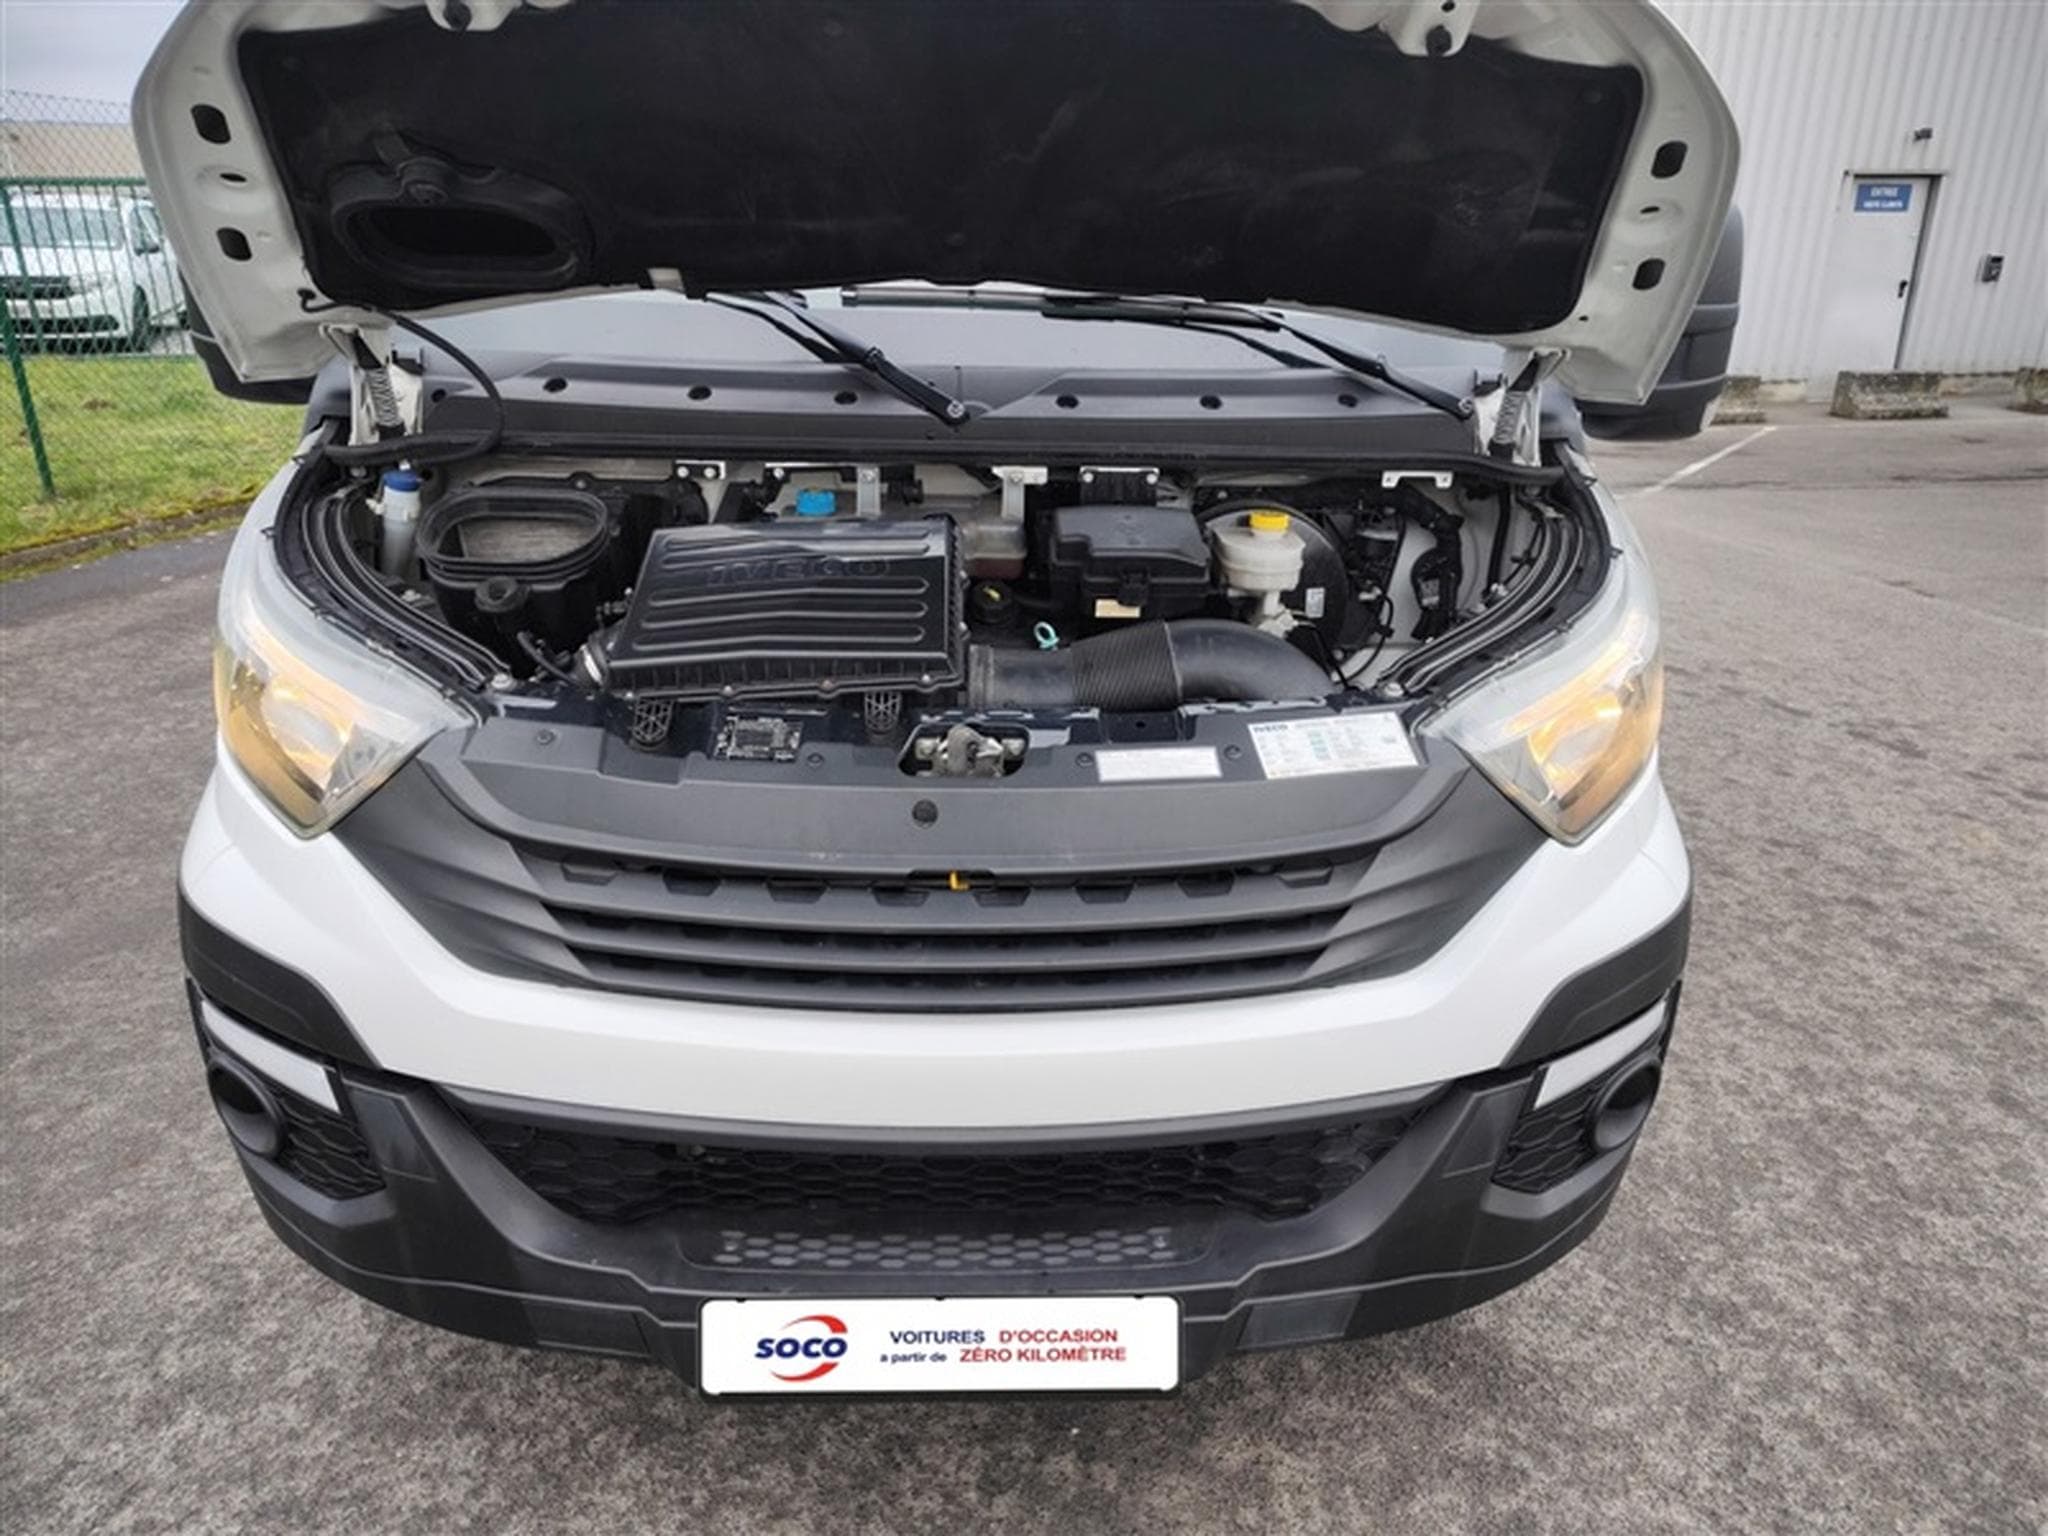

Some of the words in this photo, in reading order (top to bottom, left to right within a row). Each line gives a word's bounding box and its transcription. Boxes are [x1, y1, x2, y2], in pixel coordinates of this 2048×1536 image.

[890, 1330, 986, 1344] VOITURES
[999, 1329, 1118, 1344] D'OCCASION
[755, 1337, 848, 1359] SOCO
[891, 1353, 927, 1365] partir
[929, 1353, 947, 1363] de
